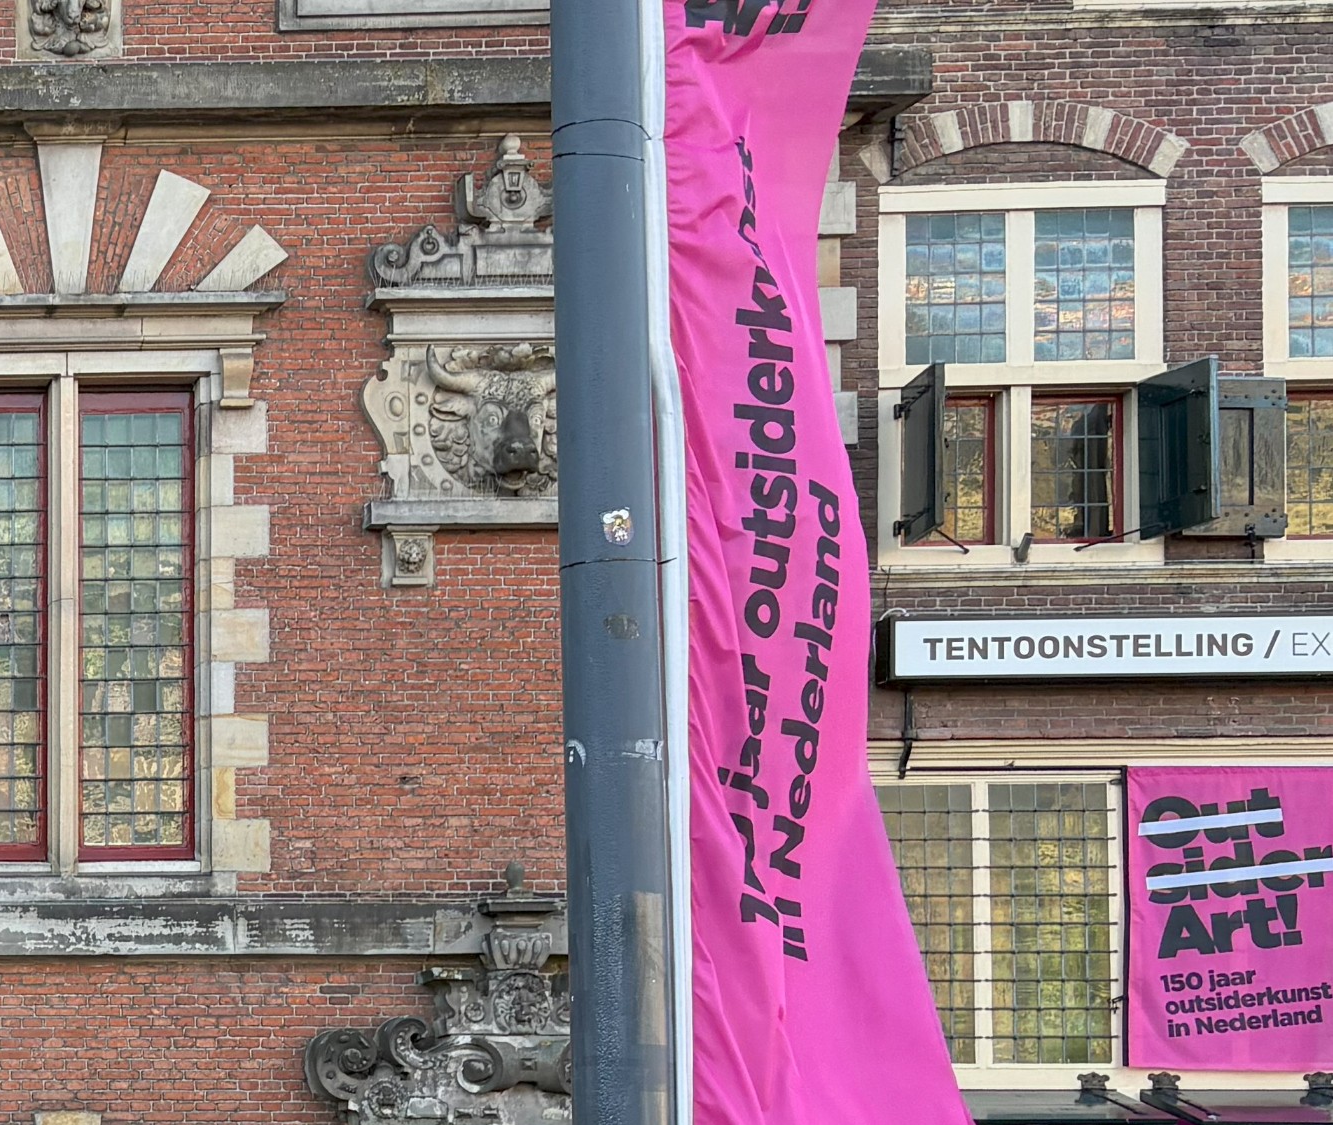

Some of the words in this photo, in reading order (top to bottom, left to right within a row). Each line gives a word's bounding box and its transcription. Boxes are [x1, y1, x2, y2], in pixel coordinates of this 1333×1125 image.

[923, 632, 1254, 661] TENTOONSTELLING
[770, 479, 840, 880] Nederland
[1141, 788, 1285, 849] Out
[1158, 893, 1303, 960] Art!
[1160, 971, 1204, 993] 150
[1208, 968, 1257, 992] jaar
[1165, 982, 1333, 1015] outsiderkunst
[1167, 1019, 1191, 1038] in
[1196, 1005, 1323, 1036] Nederland
